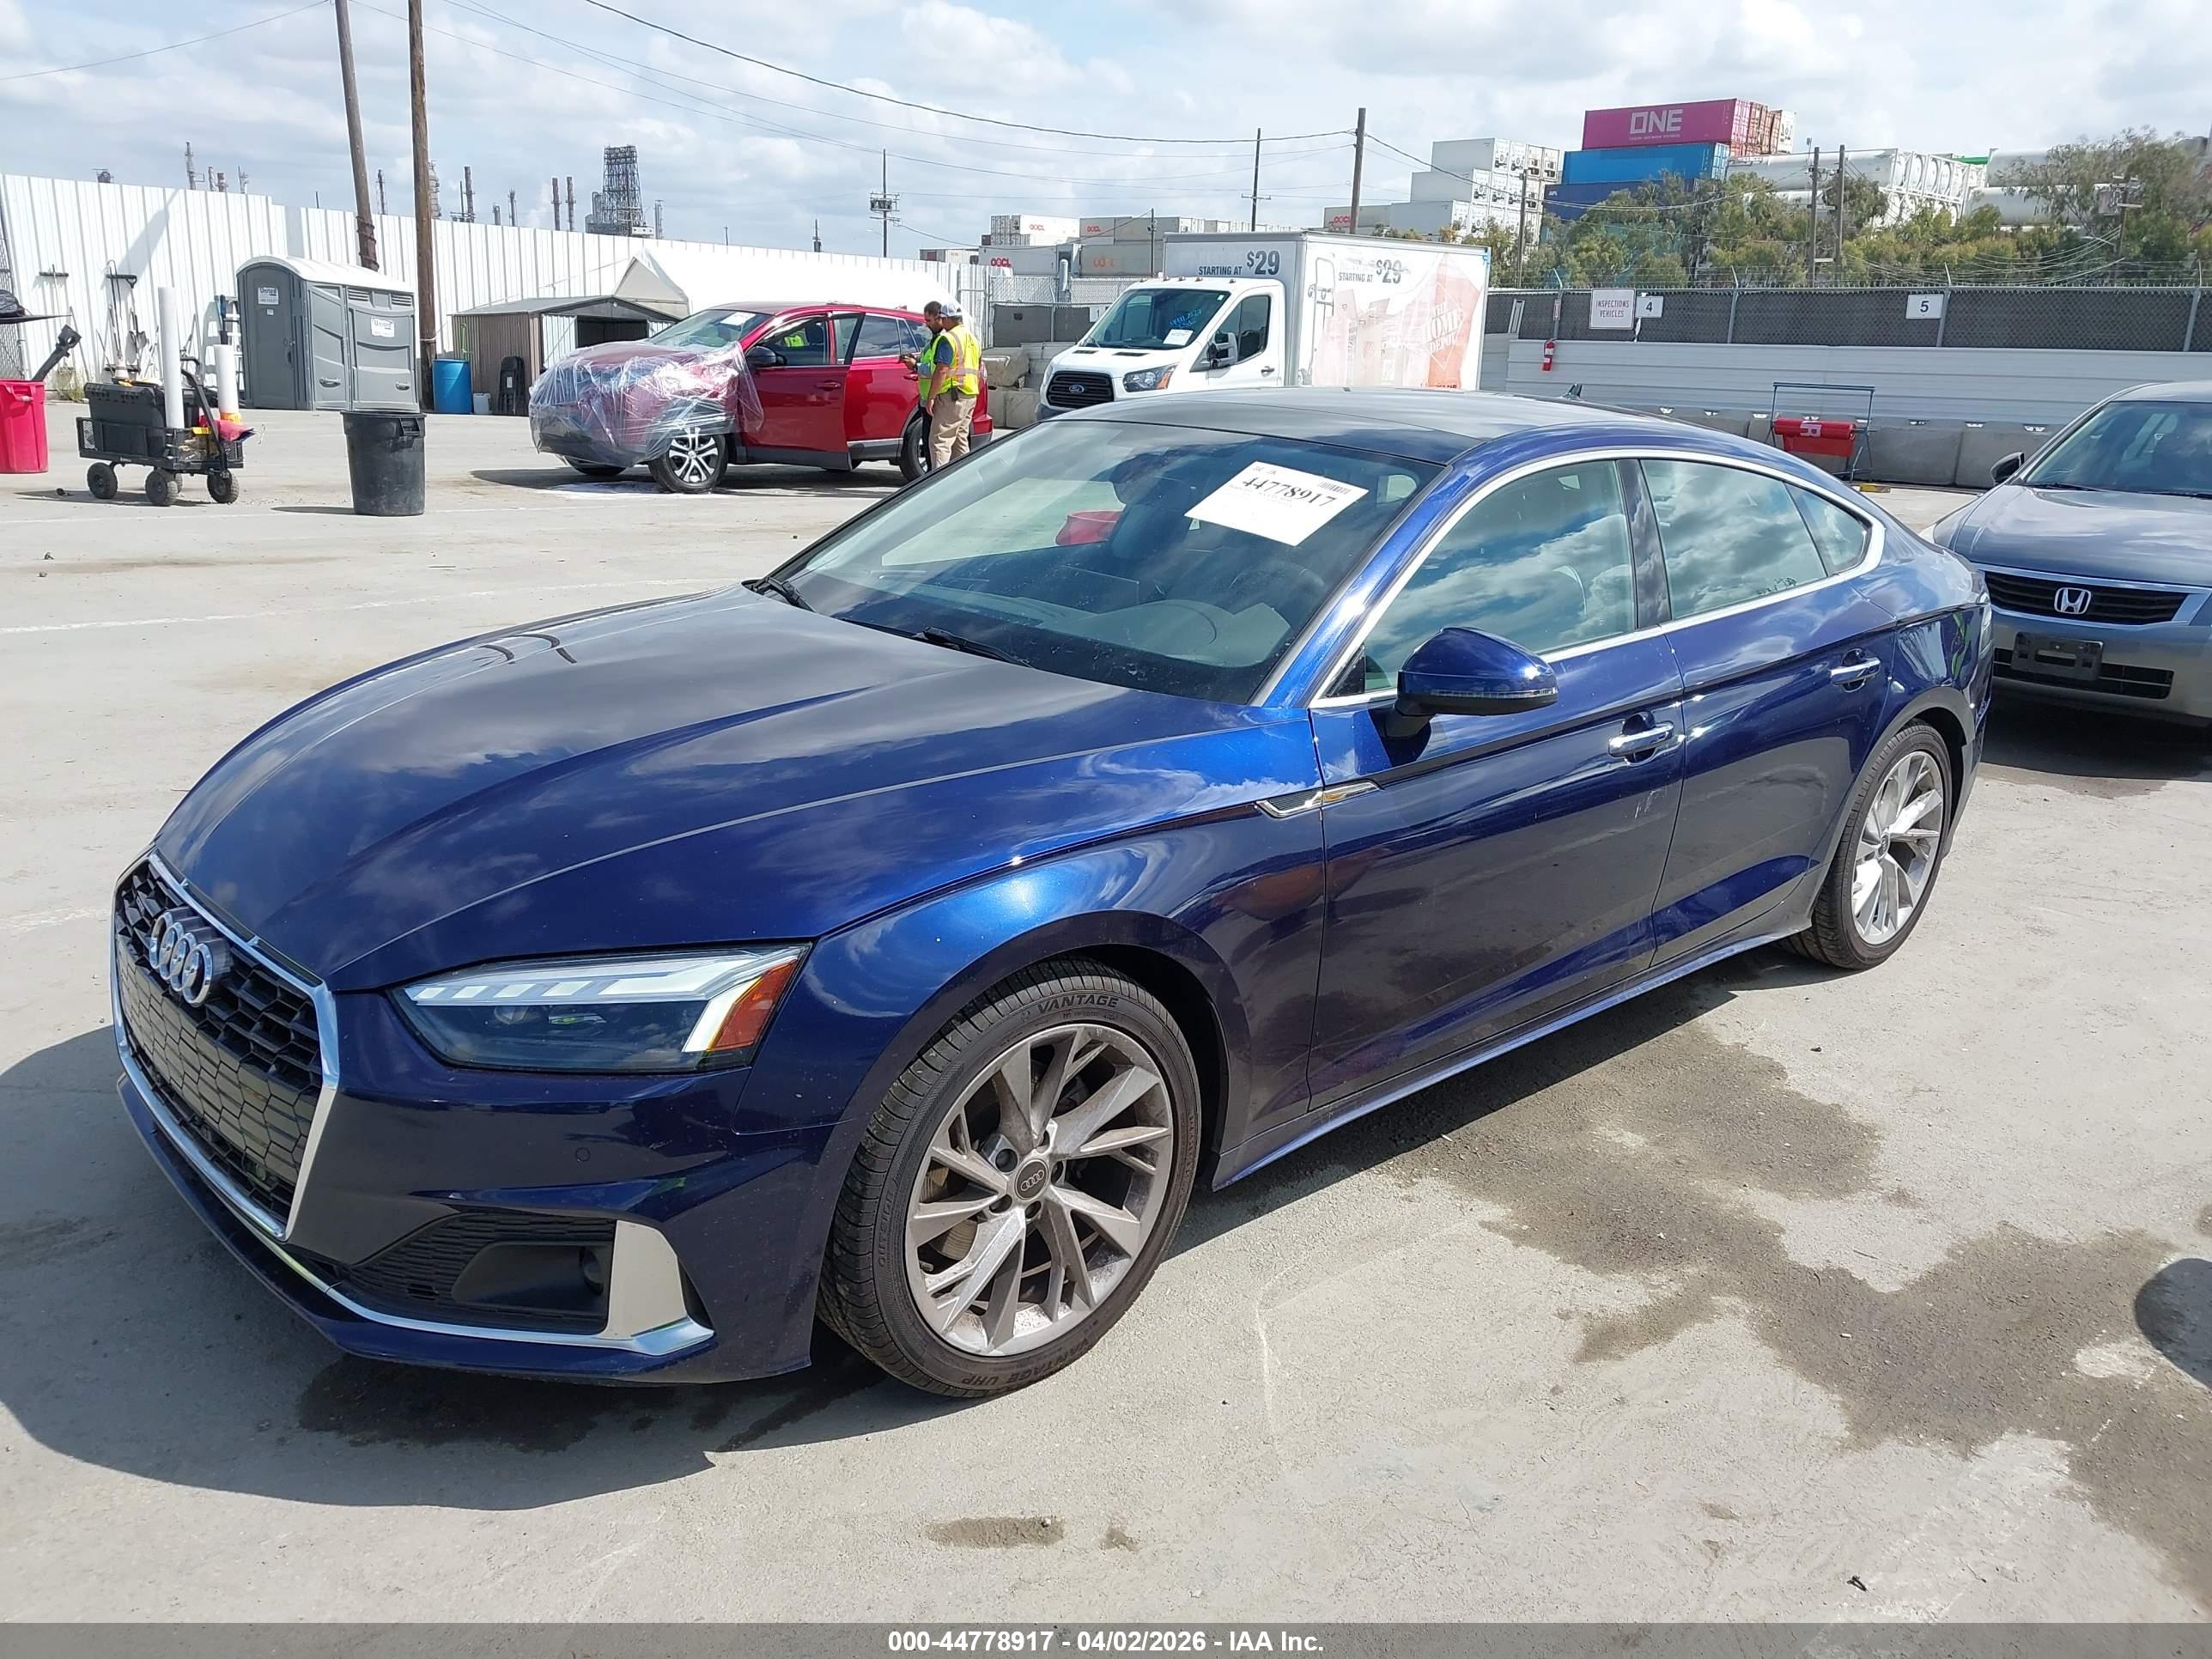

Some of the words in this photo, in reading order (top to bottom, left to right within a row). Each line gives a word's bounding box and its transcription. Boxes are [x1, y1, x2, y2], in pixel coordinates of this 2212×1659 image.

[1629, 108, 1683, 134] ONE
[990, 258, 1012, 268] OOCL
[1198, 265, 1231, 276] STARTING
[1233, 266, 1243, 276] AT
[1246, 250, 1280, 276] $29
[1338, 271, 1365, 283] STARTING
[1366, 274, 1374, 283] AT
[1376, 258, 1402, 284] $29
[1595, 300, 1630, 308] INSPECTIONS
[1645, 301, 1653, 313] 4
[1920, 301, 1929, 313] 5
[1243, 477, 1337, 507] 44778917
[1037, 994, 1119, 1014] VANTAGE
[961, 1374, 1000, 1386] UHP
